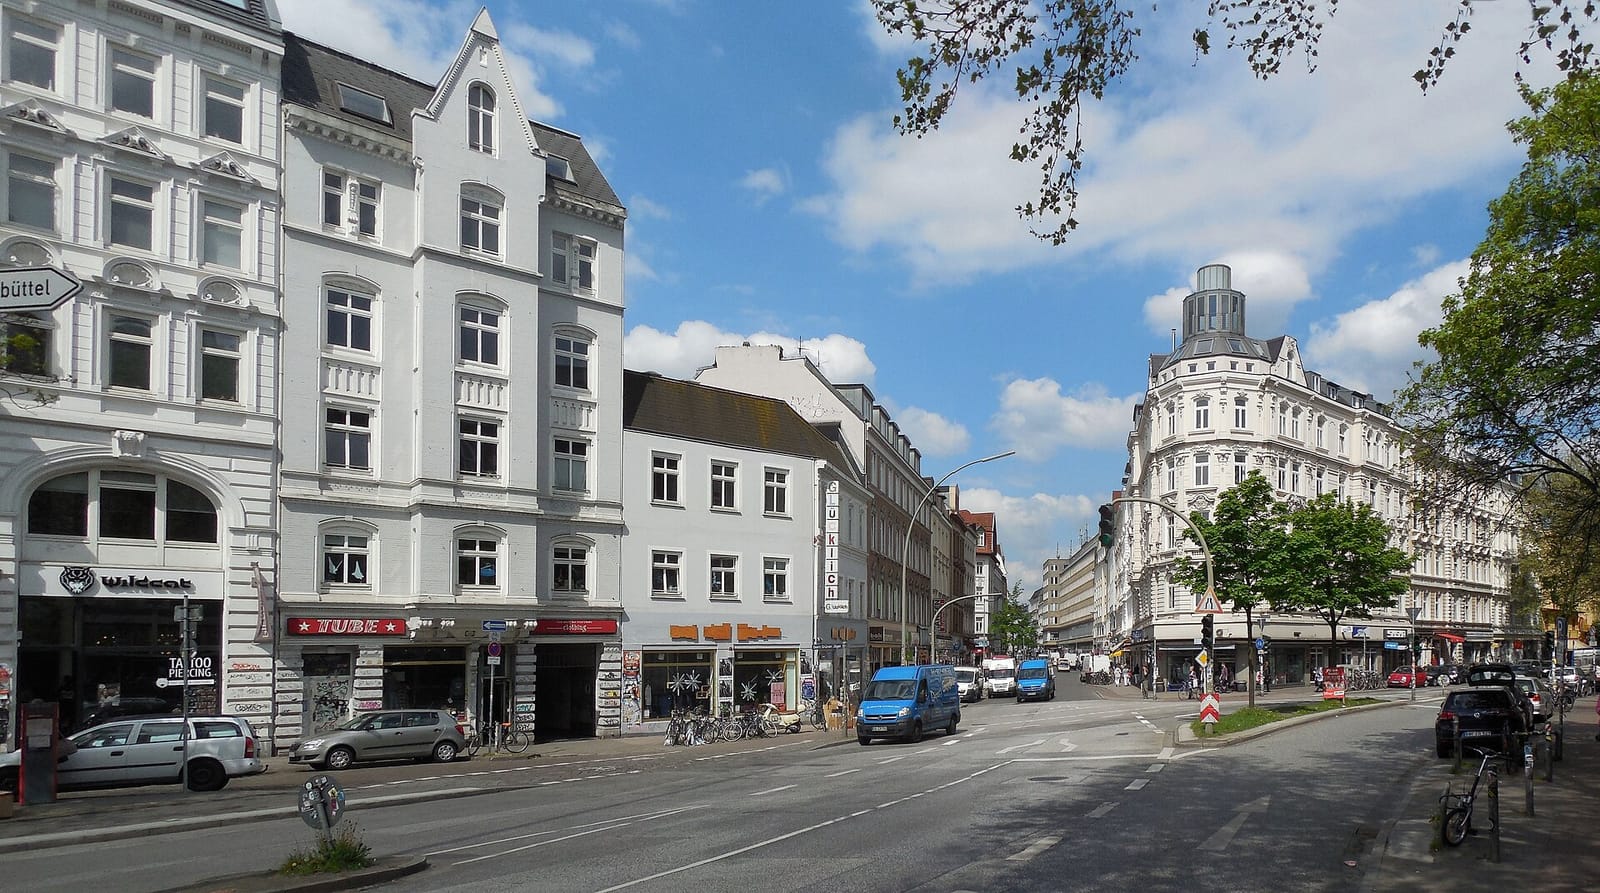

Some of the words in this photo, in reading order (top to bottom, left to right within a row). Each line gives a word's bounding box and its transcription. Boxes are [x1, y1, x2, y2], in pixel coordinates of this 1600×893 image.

[1, 279, 50, 298] büttel
[317, 619, 380, 634] TUBE
[168, 657, 212, 669] TATOO
